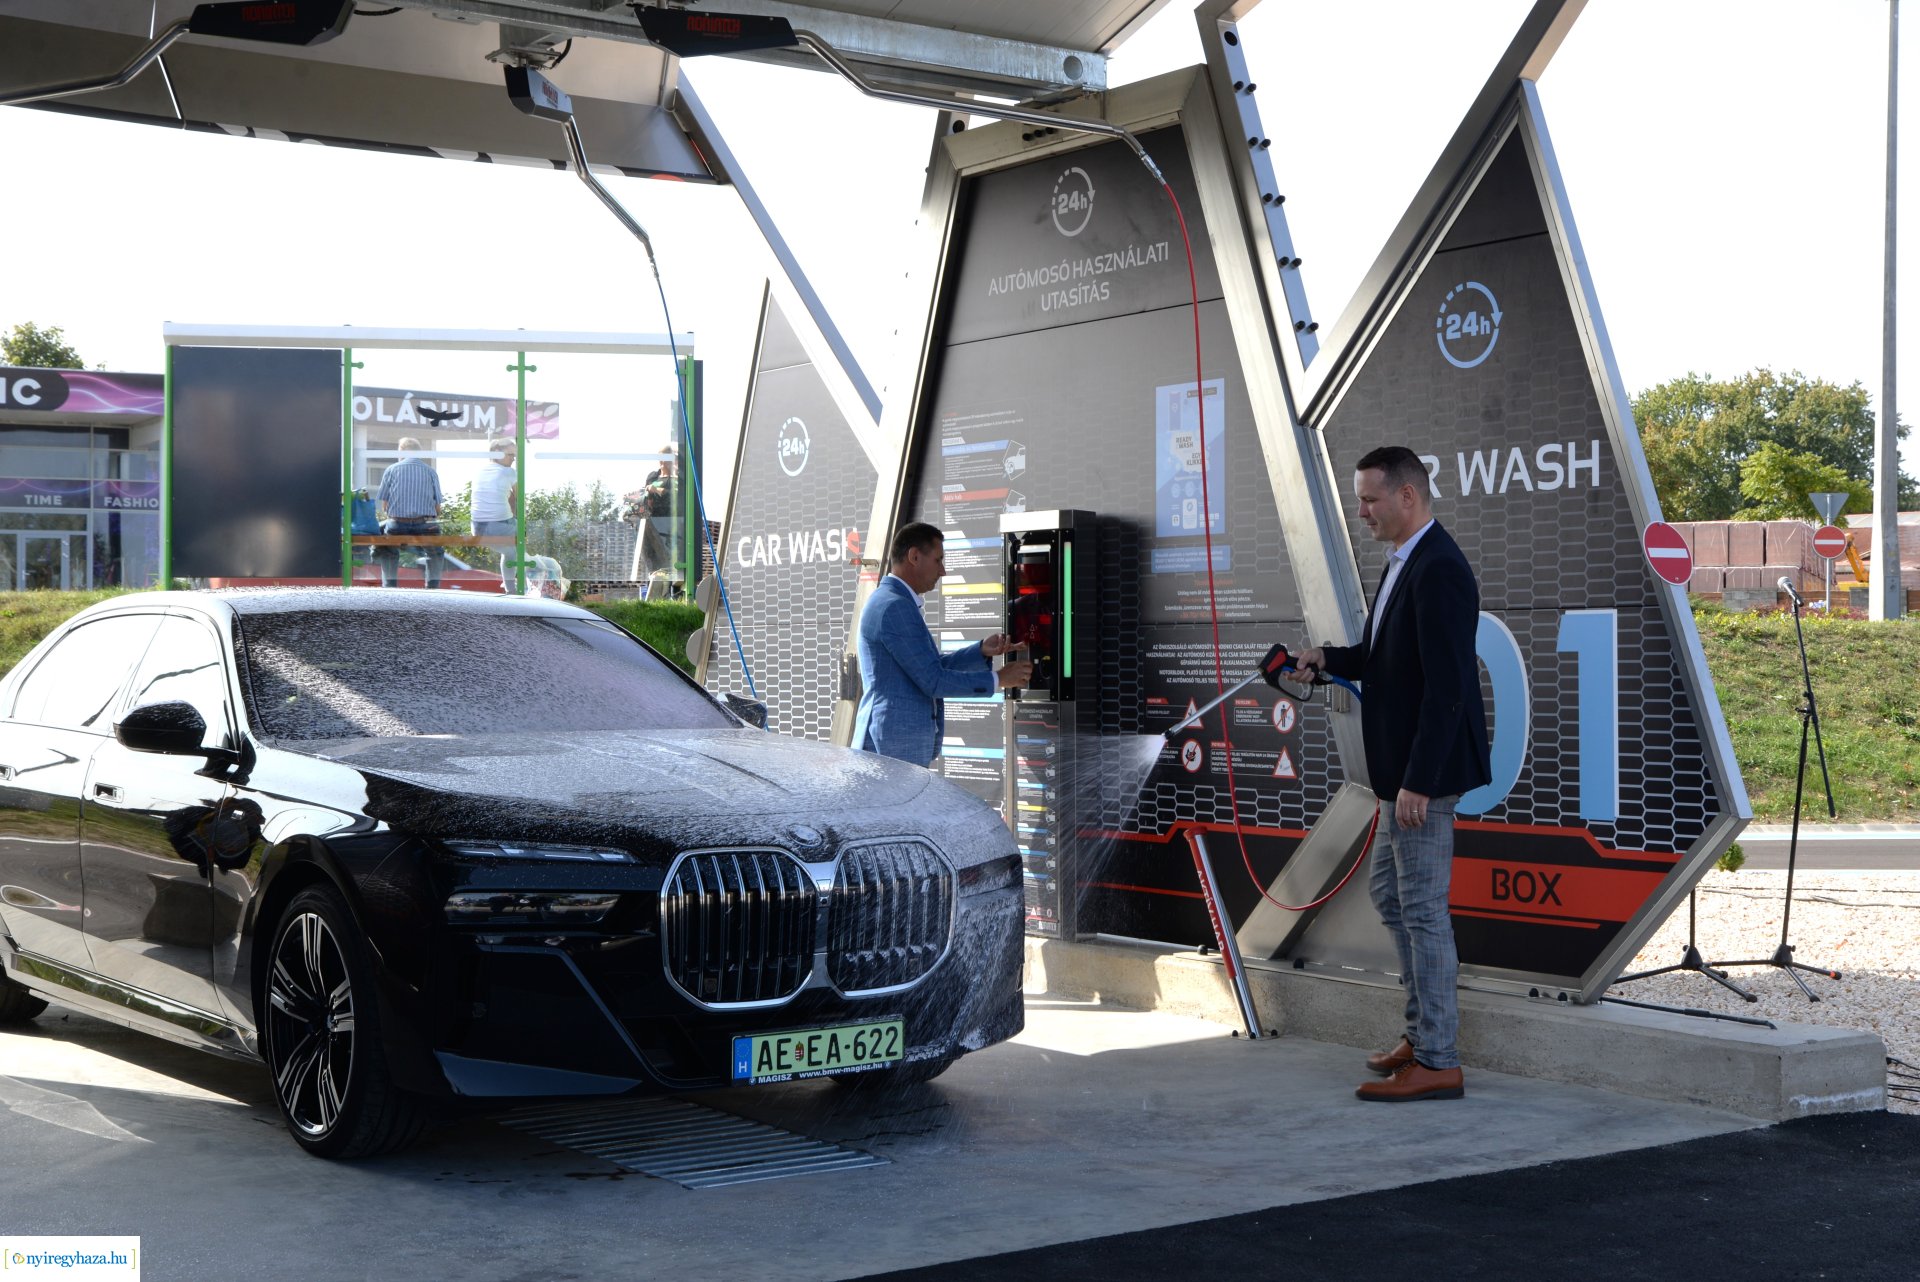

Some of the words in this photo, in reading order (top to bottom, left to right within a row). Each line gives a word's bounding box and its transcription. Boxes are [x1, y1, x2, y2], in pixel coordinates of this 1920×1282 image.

[1058, 190, 1087, 214] 24h
[988, 259, 1070, 296] AUTÓMOSÓ
[1072, 241, 1169, 279] HASZNÁLATI
[1041, 279, 1110, 311] UTASÍTÁS
[1445, 311, 1491, 340] 24h
[353, 391, 496, 429] OLÁRIUM
[782, 437, 805, 457] 24h
[1457, 439, 1600, 496] WASH
[24, 494, 63, 506] TIME
[104, 496, 159, 508] FASHIO
[737, 534, 782, 568] CAR
[1453, 608, 1619, 820] 01
[1491, 867, 1562, 906] BOX
[738, 1061, 748, 1073] H
[757, 1038, 792, 1072] AE
[807, 1025, 898, 1067] EA-622
[758, 1073, 793, 1084] MAGISZ
[799, 1062, 883, 1078] www.bmw-magisz.hu
